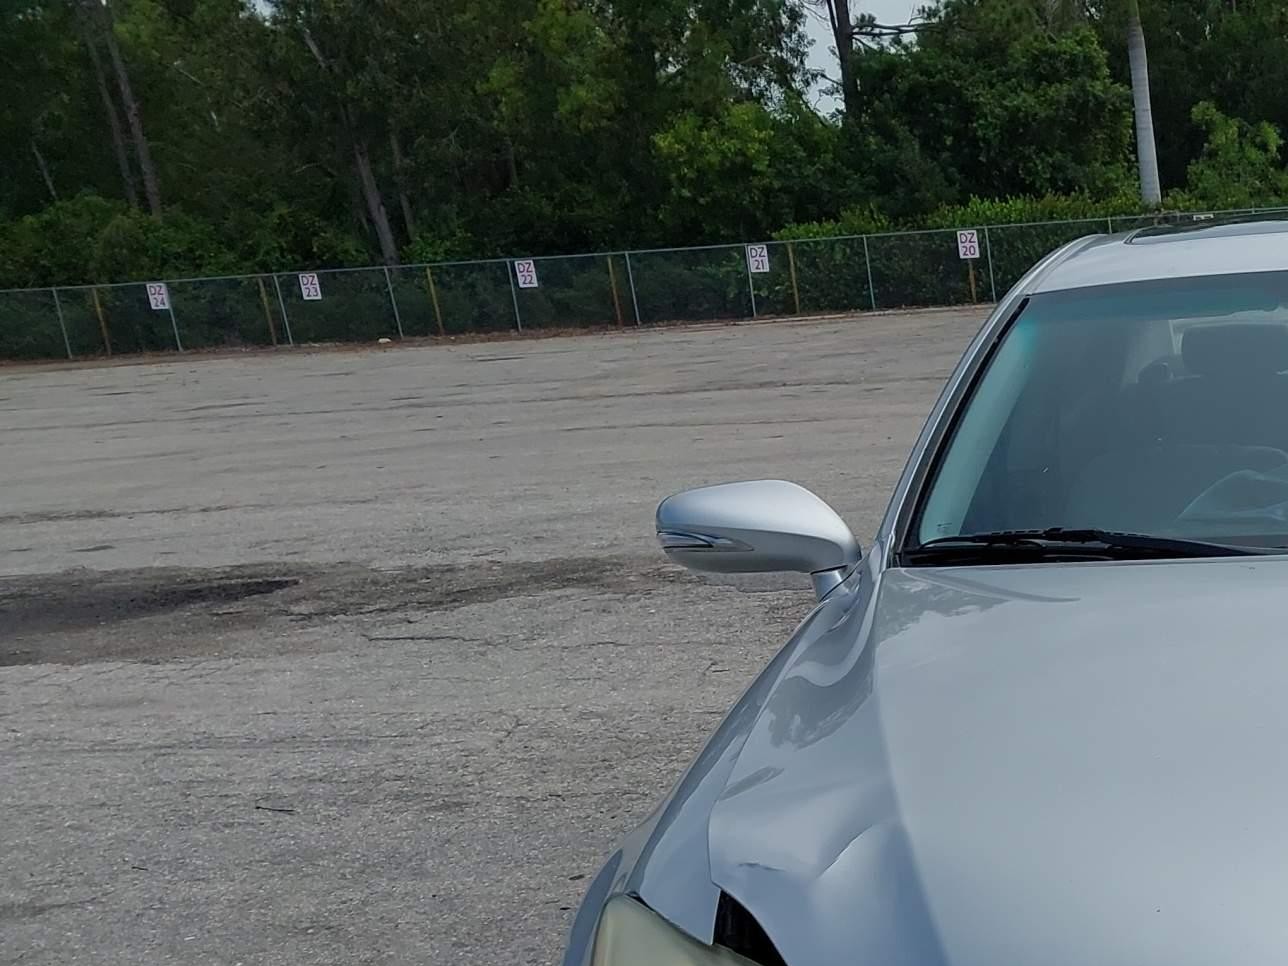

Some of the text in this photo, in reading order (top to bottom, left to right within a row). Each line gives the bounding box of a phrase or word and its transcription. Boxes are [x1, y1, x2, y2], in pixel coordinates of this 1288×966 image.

[960, 232, 976, 244] DZ
[749, 247, 766, 258] DZ
[961, 245, 976, 256] 20
[517, 262, 533, 274] DZ
[755, 259, 765, 270] 21
[301, 275, 316, 286] DZ
[521, 274, 534, 285] 22
[149, 285, 164, 296] DZ
[305, 287, 319, 297] 23
[153, 297, 166, 307] 24
